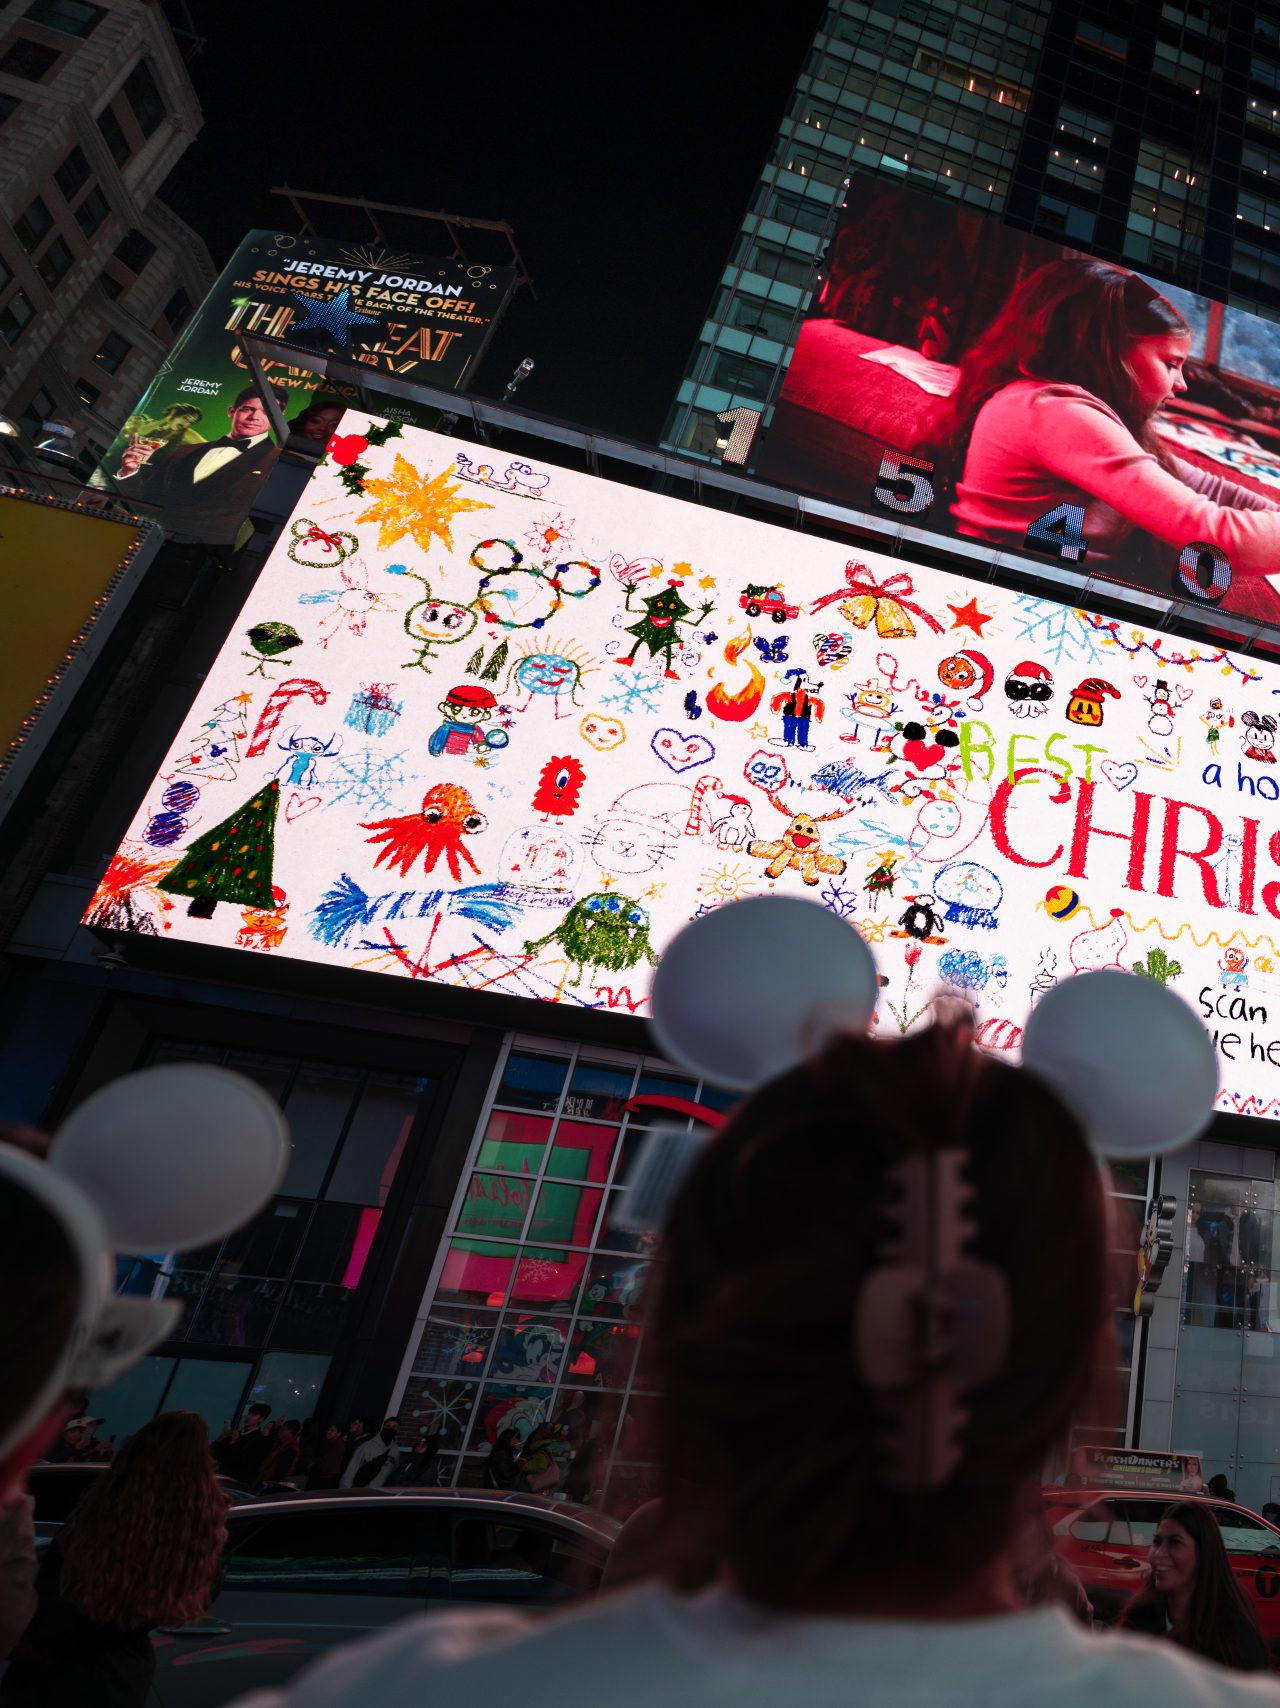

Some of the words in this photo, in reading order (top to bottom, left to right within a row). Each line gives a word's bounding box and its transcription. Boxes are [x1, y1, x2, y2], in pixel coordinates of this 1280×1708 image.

[252, 269, 319, 291] SINGS
[366, 286, 422, 306] FACE
[425, 296, 476, 315] OFF!
[372, 274, 464, 298] JORDAN
[232, 281, 252, 290] HIS
[254, 283, 287, 295] VOICE
[365, 300, 395, 311] BACK
[395, 304, 412, 313] OF
[413, 307, 434, 317] THE
[176, 385, 220, 397] JORDAN
[181, 377, 223, 389] JEREMY
[267, 376, 303, 389] NEW
[383, 406, 412, 417] AISHA
[959, 719, 1109, 787] BEST
[1202, 763, 1222, 788] a
[1198, 986, 1268, 1025] scan
